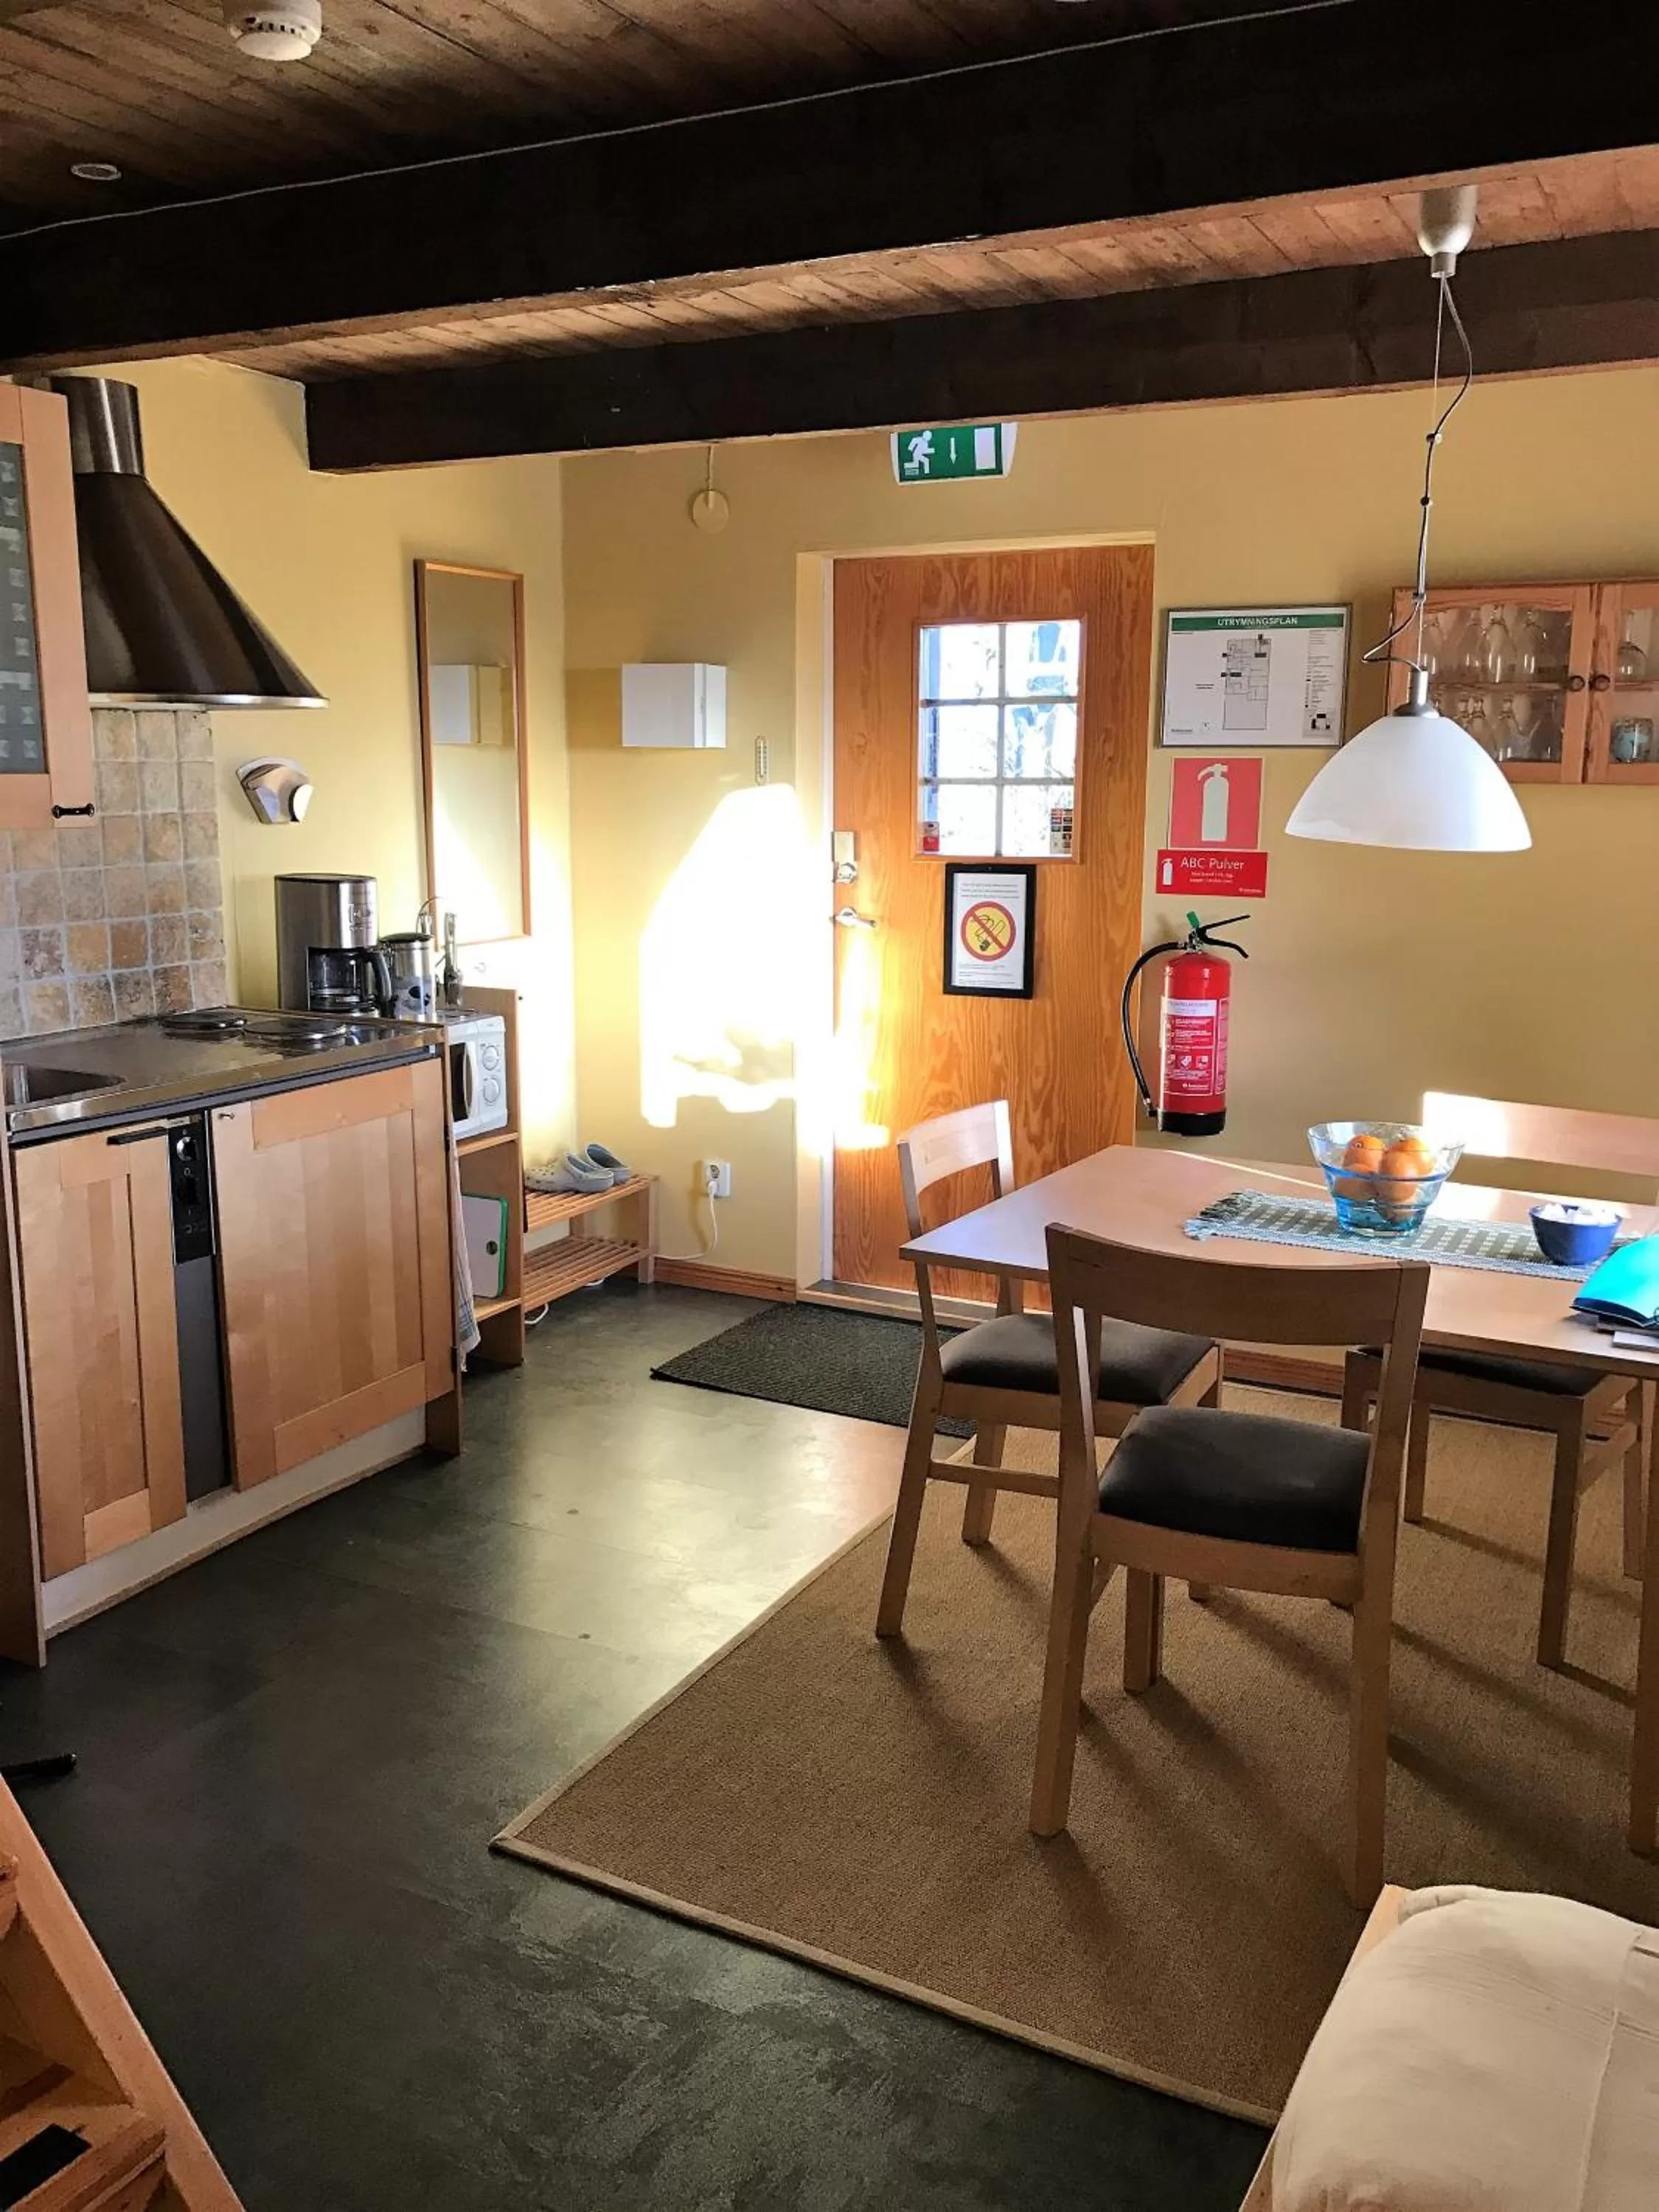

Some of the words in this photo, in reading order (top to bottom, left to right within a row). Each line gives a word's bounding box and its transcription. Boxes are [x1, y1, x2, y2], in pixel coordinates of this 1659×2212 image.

[1217, 616, 1298, 626] UTRYMNINGSPLAN
[1180, 857, 1206, 868] ABC
[1209, 858, 1245, 870] Pulver
